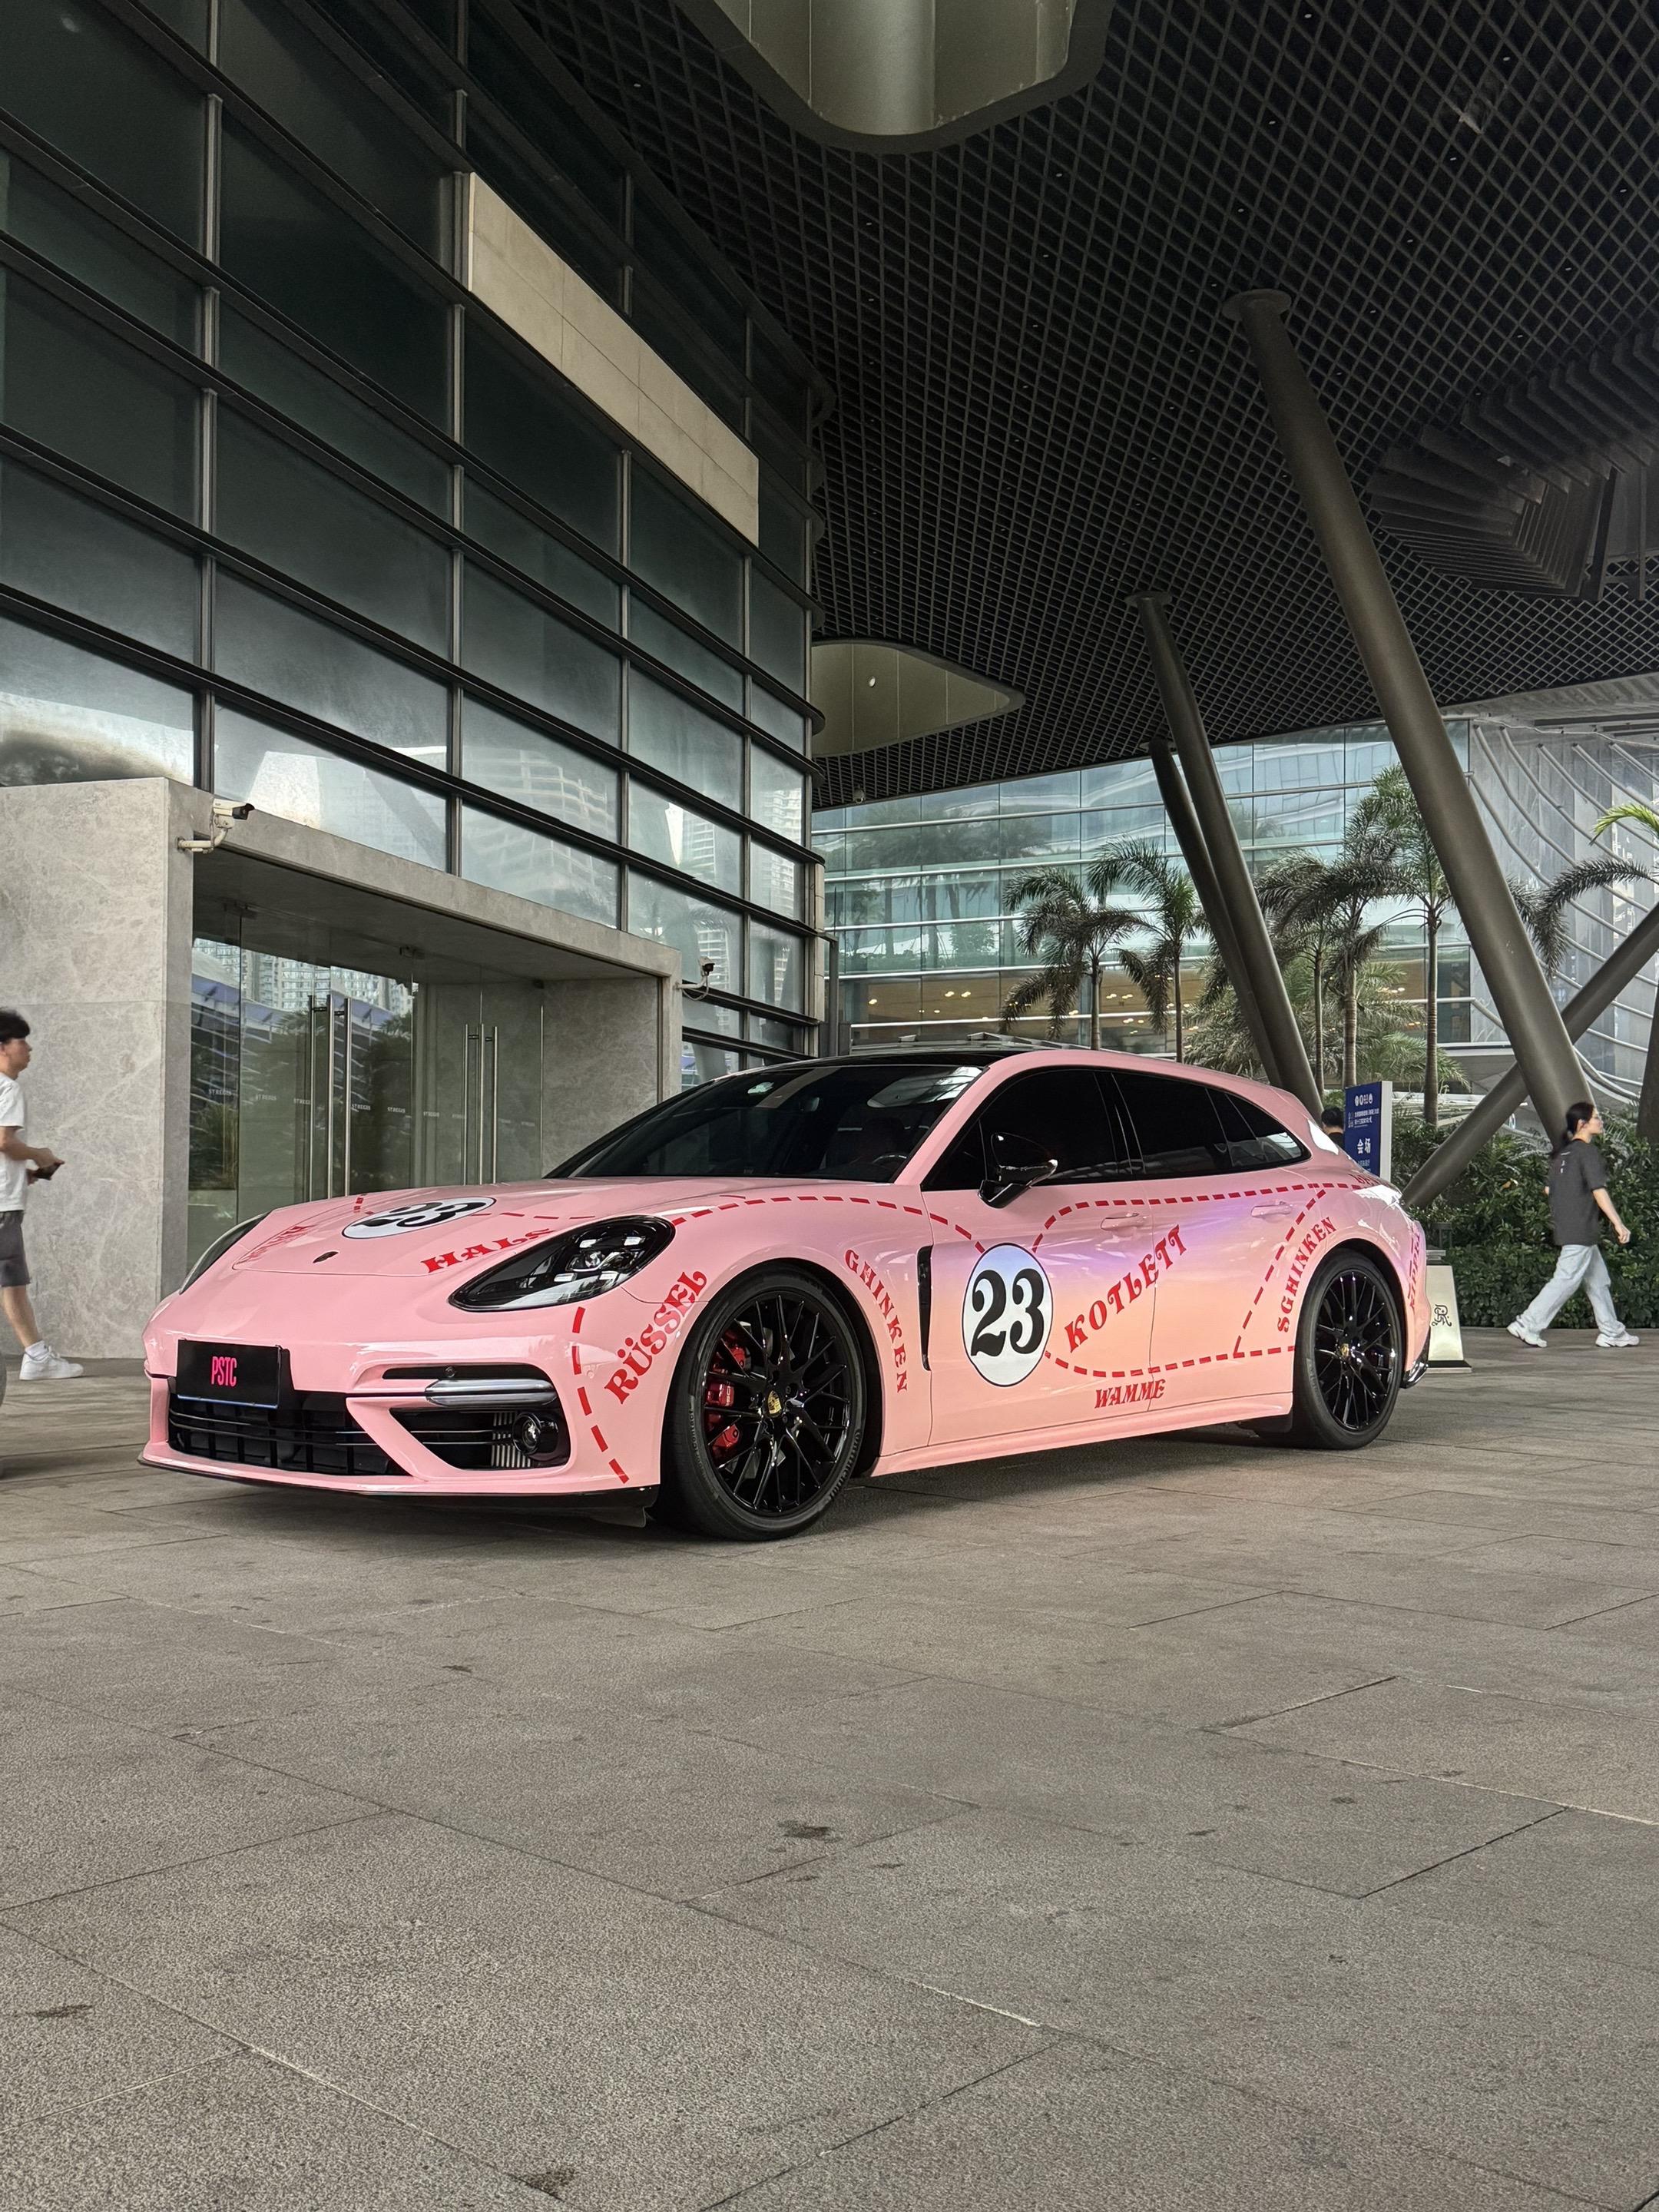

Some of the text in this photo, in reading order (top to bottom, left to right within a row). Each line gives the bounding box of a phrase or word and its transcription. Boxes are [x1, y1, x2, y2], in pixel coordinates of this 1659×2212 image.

[1357, 1137, 1371, 1154] 会场
[352, 1202, 487, 1227] 23
[422, 1228, 556, 1273] HALS
[1065, 1224, 1187, 1353] KOTLETT
[970, 1268, 1045, 1356] 23
[604, 1271, 707, 1404] RÜSSEL
[211, 1356, 237, 1387] PSTC
[1094, 1379, 1165, 1409] WAMME
